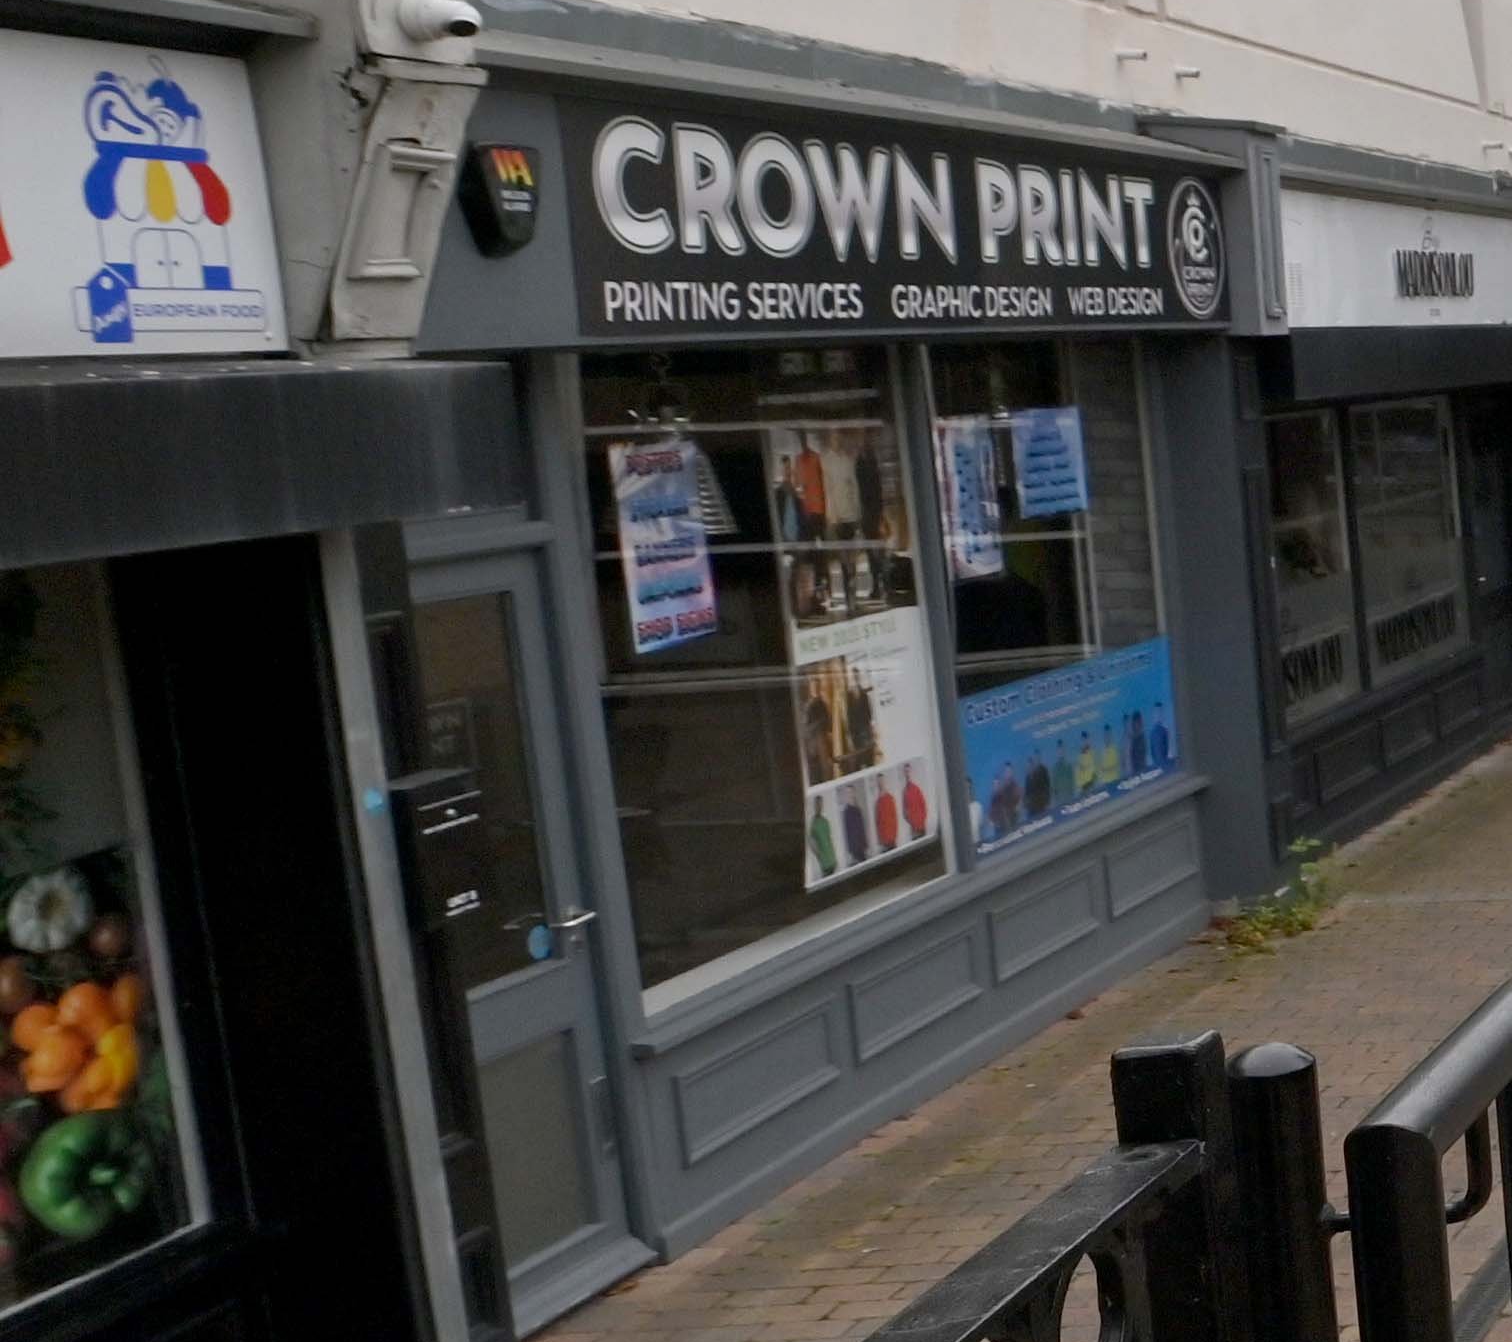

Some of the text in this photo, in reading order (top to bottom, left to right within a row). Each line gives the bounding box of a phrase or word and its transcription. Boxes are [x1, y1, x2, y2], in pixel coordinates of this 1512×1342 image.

[593, 114, 1155, 269] CROWN PRINT
[134, 303, 217, 318] EUROPEAN
[220, 304, 264, 319] FOOD
[603, 281, 1164, 323] PRINTING SERVICES GRAPHIC DESIGN WEB DESIGN
[966, 692, 1020, 727] Custom
